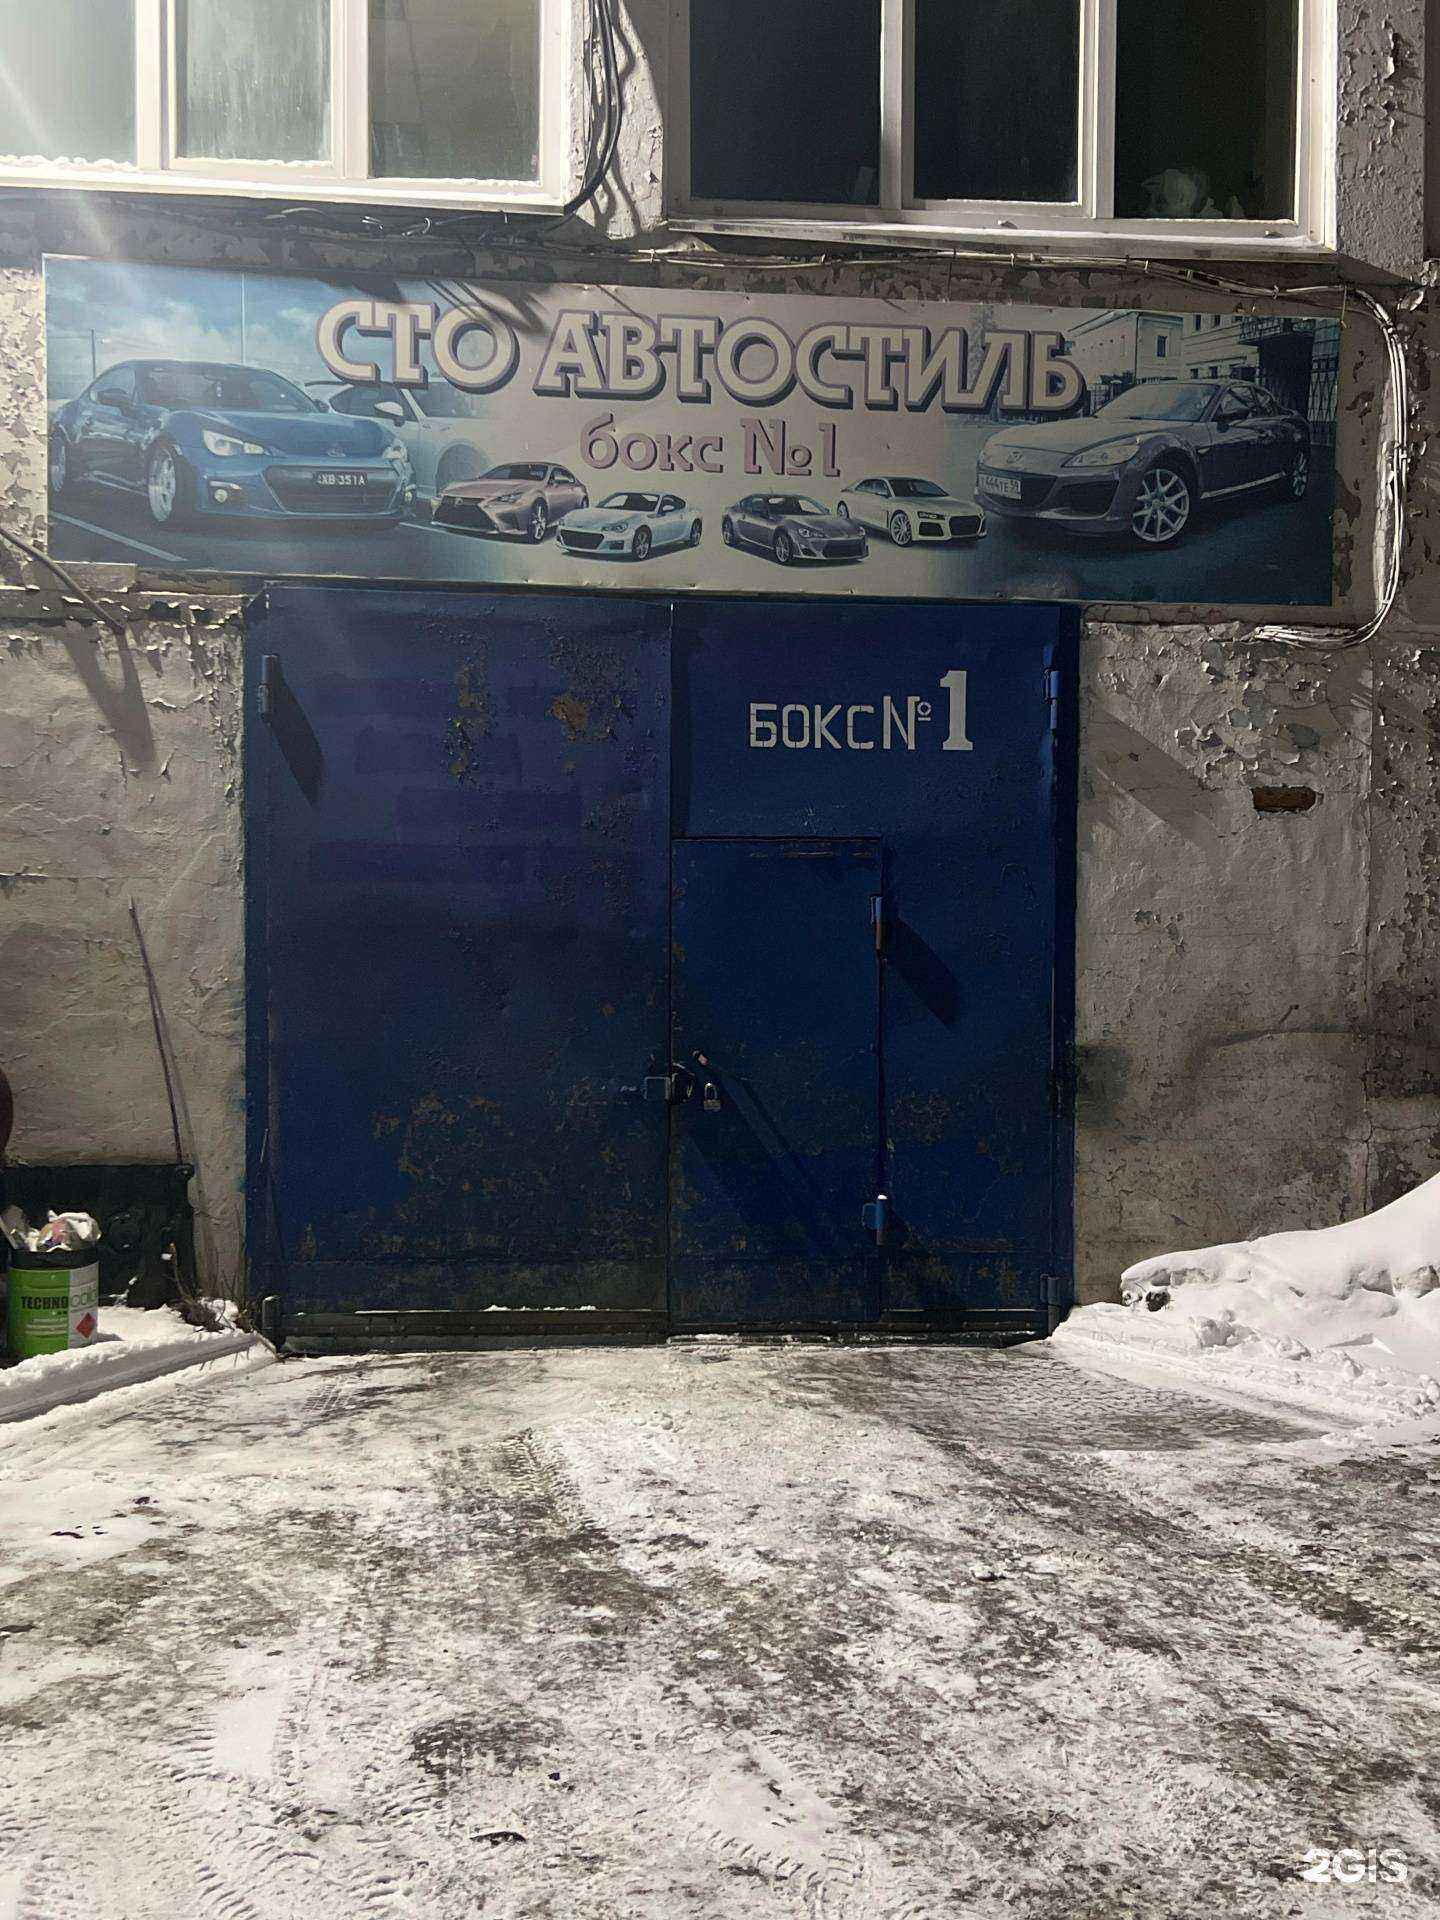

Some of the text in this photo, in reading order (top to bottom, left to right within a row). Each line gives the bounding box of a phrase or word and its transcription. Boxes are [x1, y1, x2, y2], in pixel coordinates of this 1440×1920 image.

[316, 300, 1086, 416] СТО АВТОСТИЛЬ
[580, 413, 723, 473] бокс
[750, 703, 874, 750] БОКС
